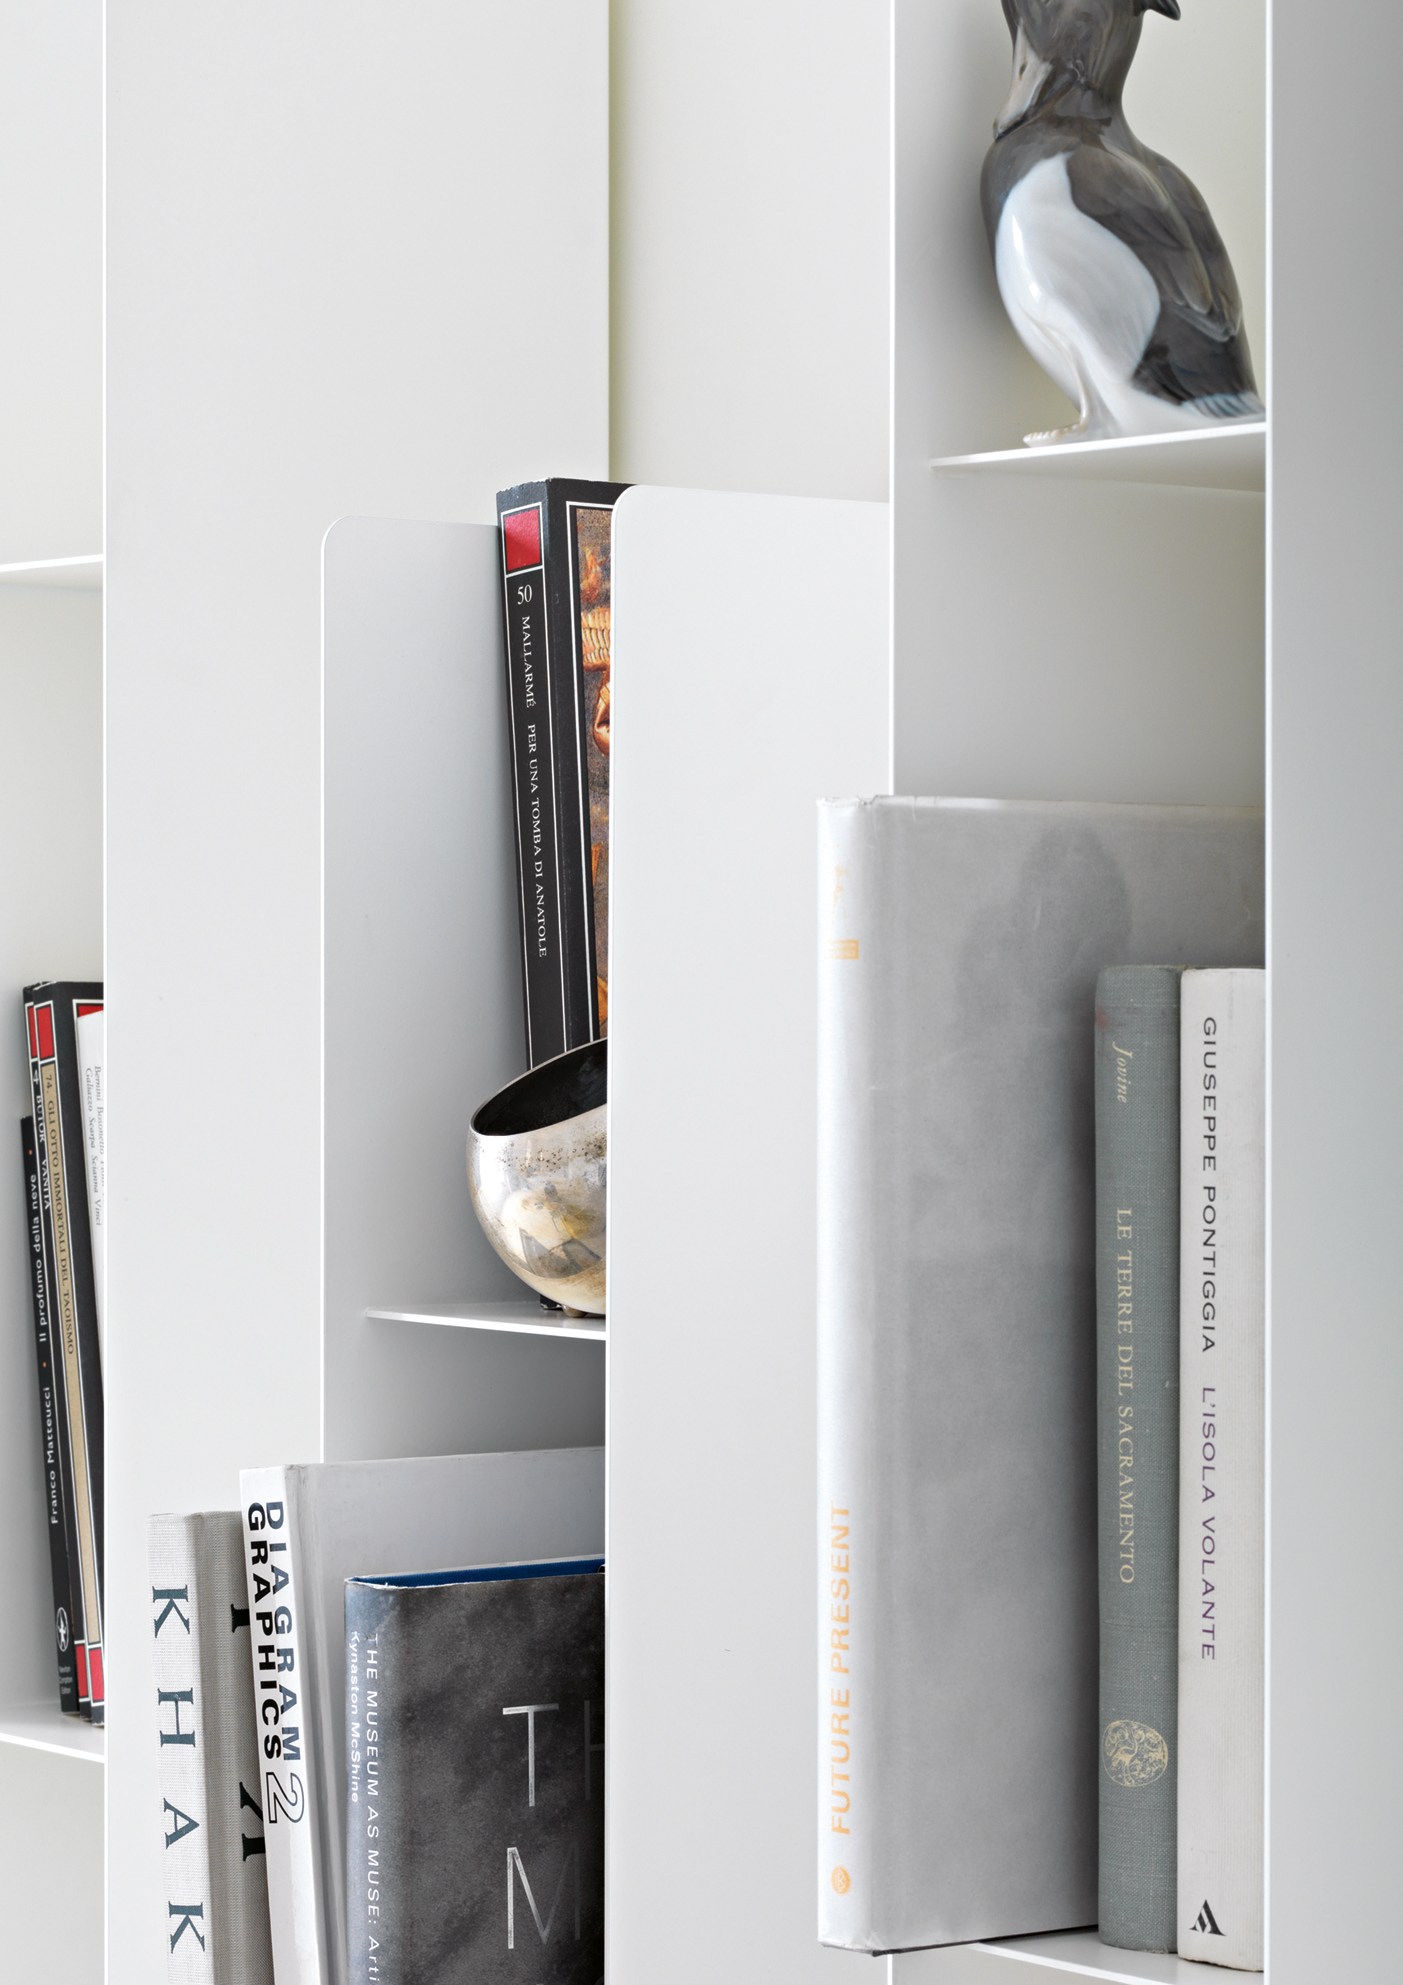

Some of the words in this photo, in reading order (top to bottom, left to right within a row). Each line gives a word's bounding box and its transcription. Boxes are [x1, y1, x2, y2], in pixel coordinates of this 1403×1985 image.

[516, 584, 533, 605] 50
[521, 616, 537, 709] MALLARMÉ
[527, 724, 537, 754] PER
[529, 758, 539, 794] UNA
[531, 797, 543, 857] TOMBA
[534, 860, 544, 878] DI
[536, 883, 548, 958] ANATOLE
[1112, 1041, 1134, 1103] Jovine
[1202, 1016, 1217, 1172] GIUSEPPE
[47, 1100, 56, 1124] GLI
[50, 1129, 59, 1167] OTTO
[30, 1174, 38, 1210] neve
[53, 1172, 66, 1253] IMMORTALI
[1116, 1207, 1133, 1240] LE
[32, 1216, 42, 1253] della
[1201, 1185, 1217, 1353] PONTIGGIA
[36, 1258, 48, 1326] profumo
[60, 1258, 69, 1286] DEL
[1117, 1249, 1133, 1335] TERRE
[63, 1289, 74, 1355] TAOISMO
[1118, 1344, 1134, 1396] DEL
[44, 1386, 55, 1464] Matteucci
[1201, 1386, 1216, 1503] L'ISOLA
[50, 1470, 59, 1524] Franco
[1118, 1406, 1135, 1585] SACRAMENTO
[830, 1500, 850, 1675] PRESENT
[1201, 1516, 1216, 1661] VOLANTE
[247, 1502, 281, 1760] GRAPHICS
[265, 1771, 304, 1825] 2
[265, 1501, 301, 1762] DIAGRAM
[364, 1632, 379, 1678] THE
[347, 1630, 361, 1715] Kynaston
[350, 1719, 360, 1804] McShine
[366, 1691, 380, 1797] MUSEUM
[831, 1688, 851, 1835] FUTURE
[366, 1805, 380, 1839] AS
[366, 1849, 381, 1925] MUSE:
